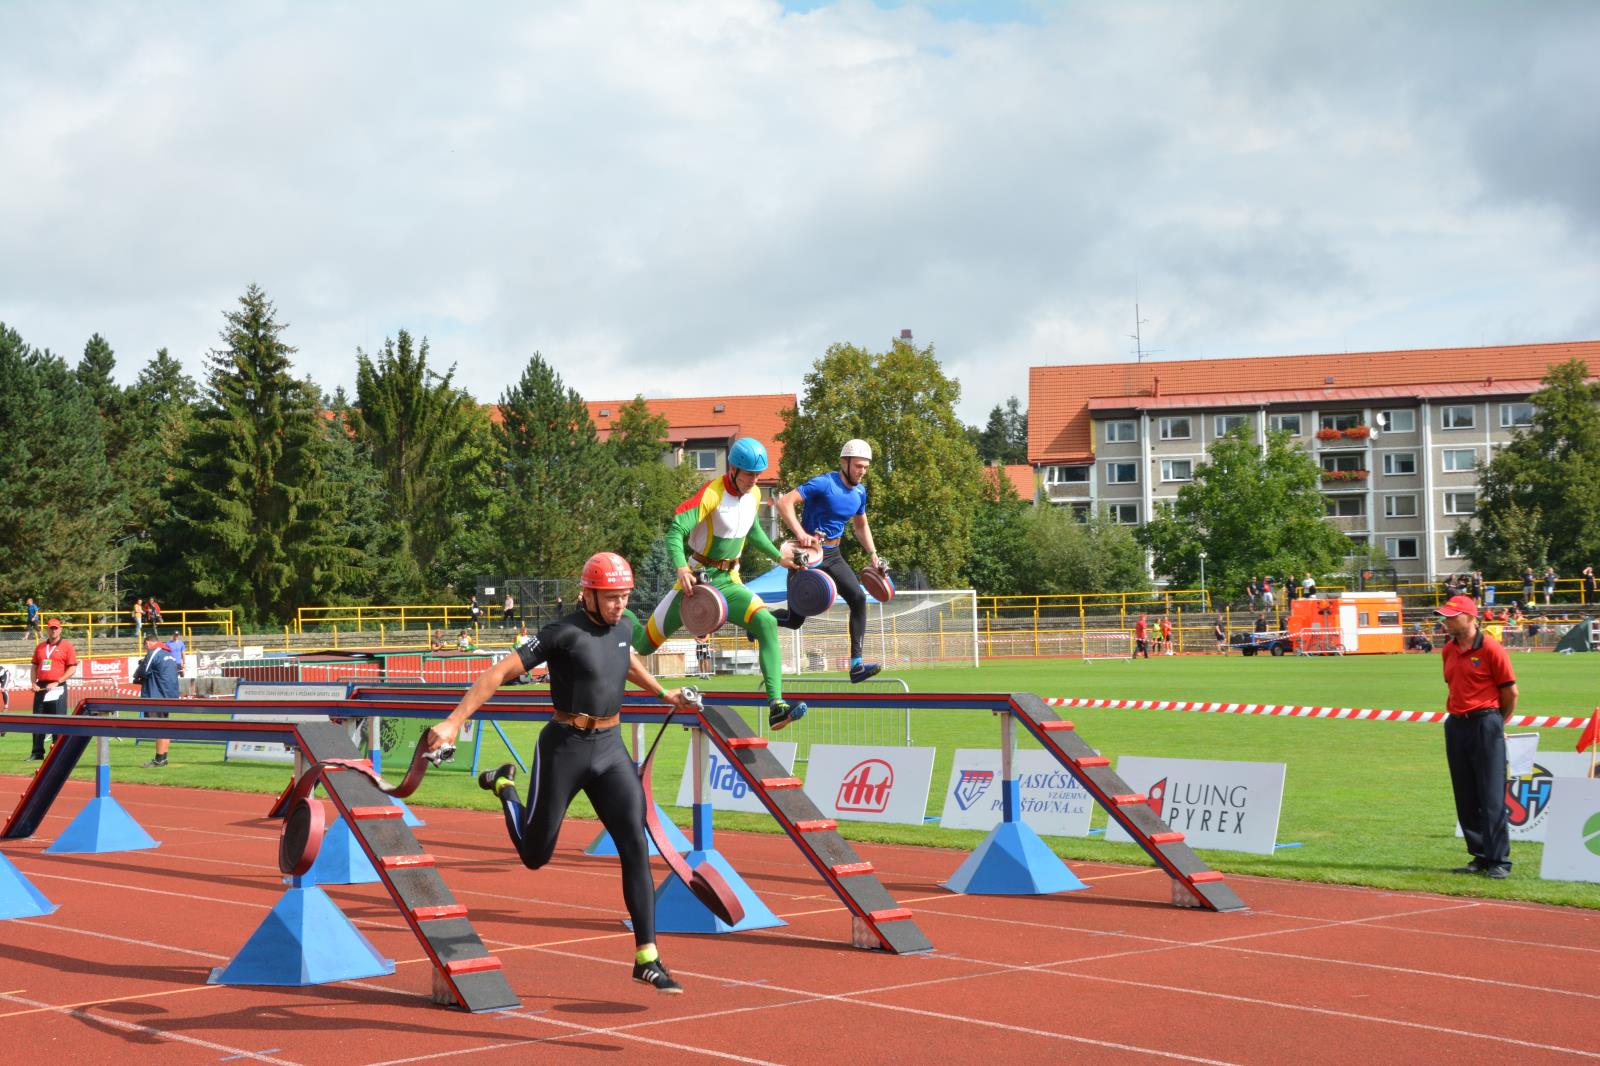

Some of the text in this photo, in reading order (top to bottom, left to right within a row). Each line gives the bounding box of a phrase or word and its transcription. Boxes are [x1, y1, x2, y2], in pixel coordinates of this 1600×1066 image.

[841, 766, 893, 805] tht
[1017, 770, 1083, 790] ASIČSK
[1172, 782, 1248, 808] LUING
[1168, 807, 1246, 834] PYREX
